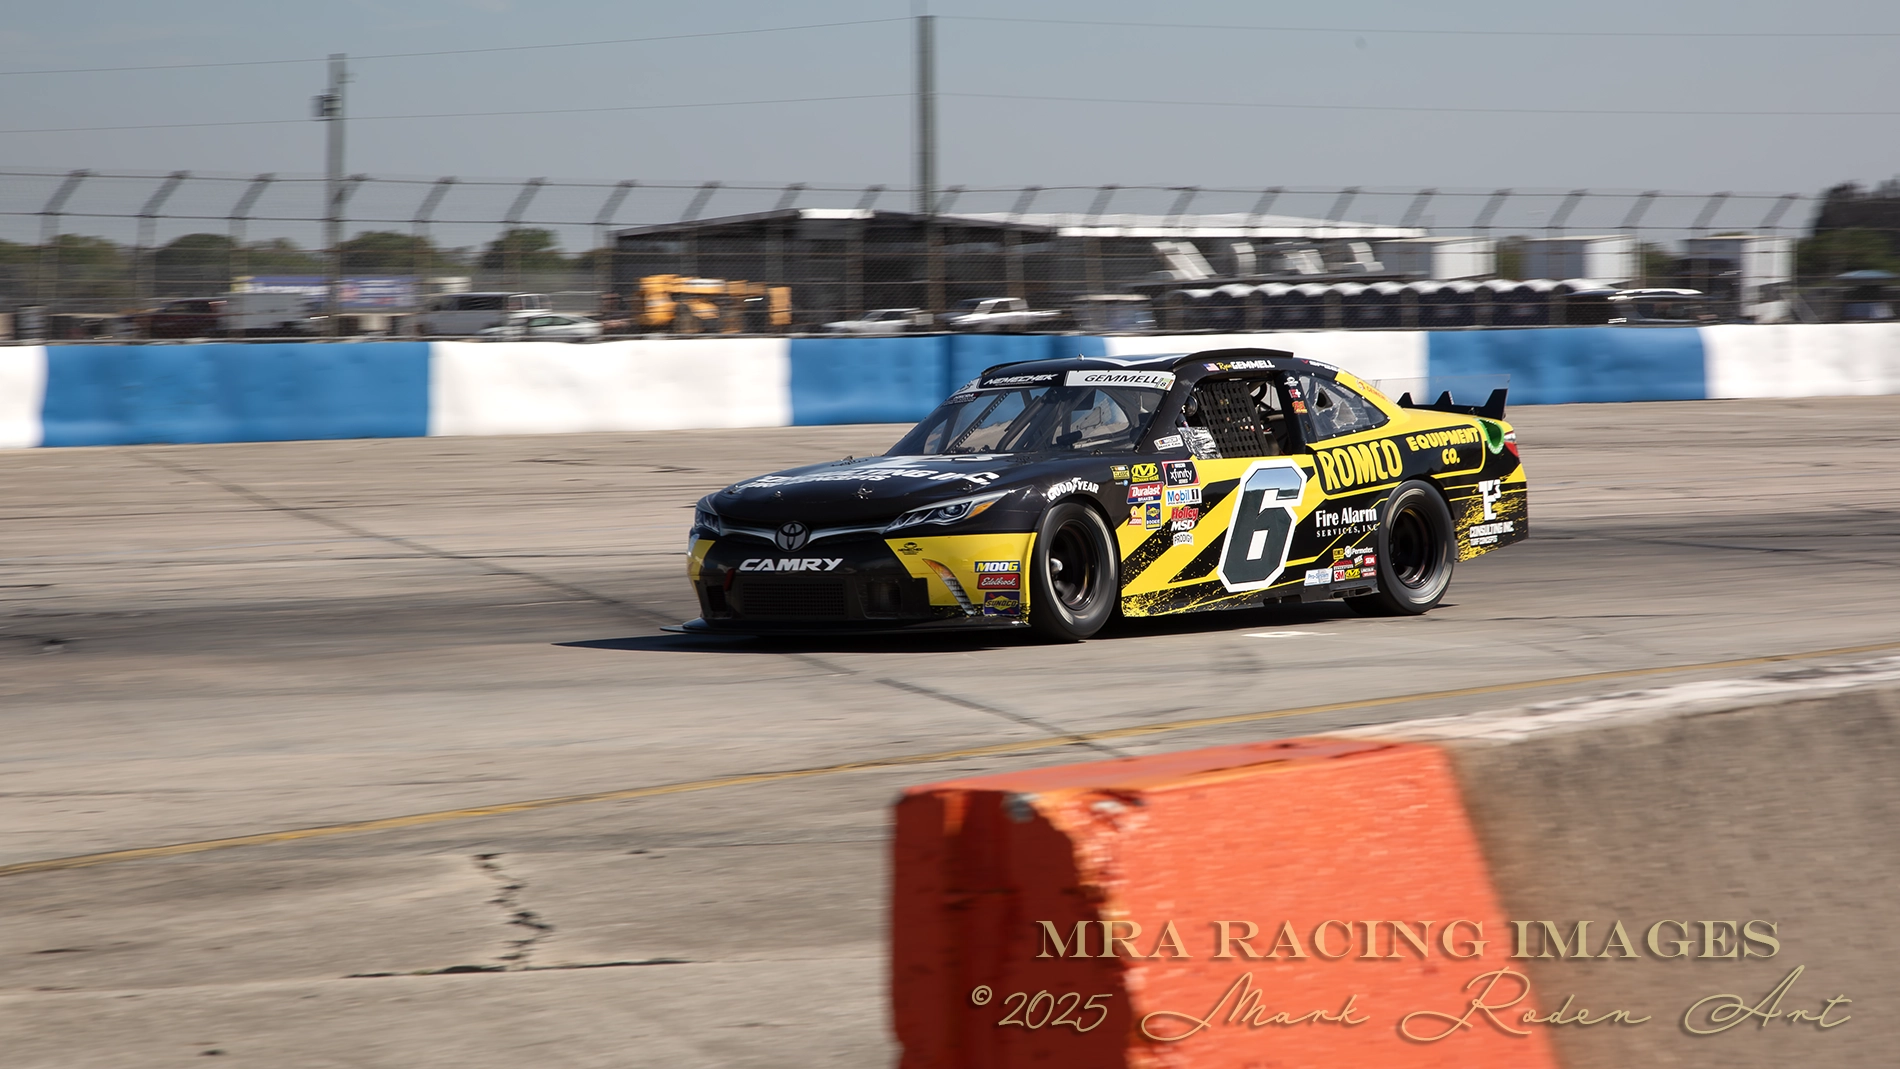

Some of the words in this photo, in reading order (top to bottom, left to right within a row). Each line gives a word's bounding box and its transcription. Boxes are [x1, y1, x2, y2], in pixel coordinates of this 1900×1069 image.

[1230, 360, 1275, 369] GEMMELL
[984, 373, 1058, 385] NEMECHEK
[1084, 374, 1158, 384] GEMMELL
[1405, 429, 1480, 451] EQUIPMENT
[1442, 449, 1460, 465] CO.
[1317, 439, 1403, 491] ROMCO
[1170, 468, 1192, 482] xfinity
[1047, 477, 1099, 500] GOODYEAR
[1131, 485, 1160, 497] Duralast
[1167, 489, 1189, 502] Mobil
[1191, 489, 1199, 500] 1
[1171, 506, 1198, 521] Holley
[1316, 510, 1339, 528] Fire
[1341, 507, 1377, 524] Alarm
[1171, 520, 1195, 531] MSD
[1221, 463, 1304, 587] 6
[1469, 522, 1503, 538] CONSULTING
[739, 558, 843, 571] CAMRY
[976, 561, 1018, 572] MOOG
[981, 577, 1015, 586] Edelbrock
[1334, 571, 1345, 580] 3M
[986, 599, 1017, 607] SUNOCO
